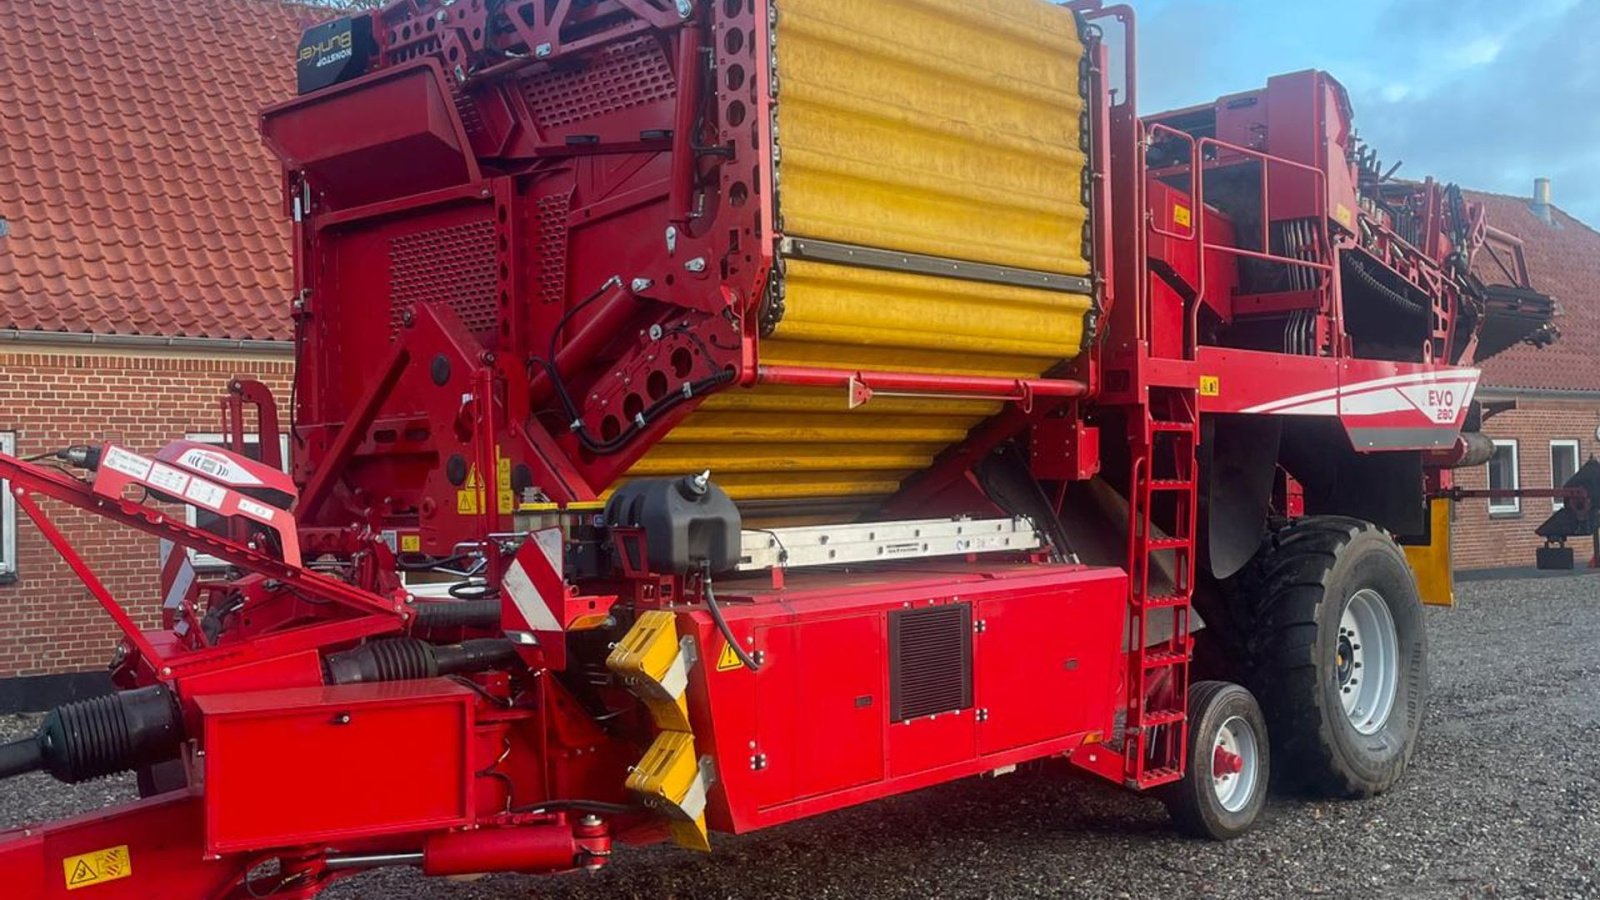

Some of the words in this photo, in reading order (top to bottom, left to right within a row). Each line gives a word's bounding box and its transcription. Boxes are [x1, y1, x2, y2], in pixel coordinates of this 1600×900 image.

[297, 31, 352, 65] Bunker
[316, 47, 352, 67] NONSTOP
[1428, 390, 1453, 406] EVO
[1437, 409, 1453, 420] 280
